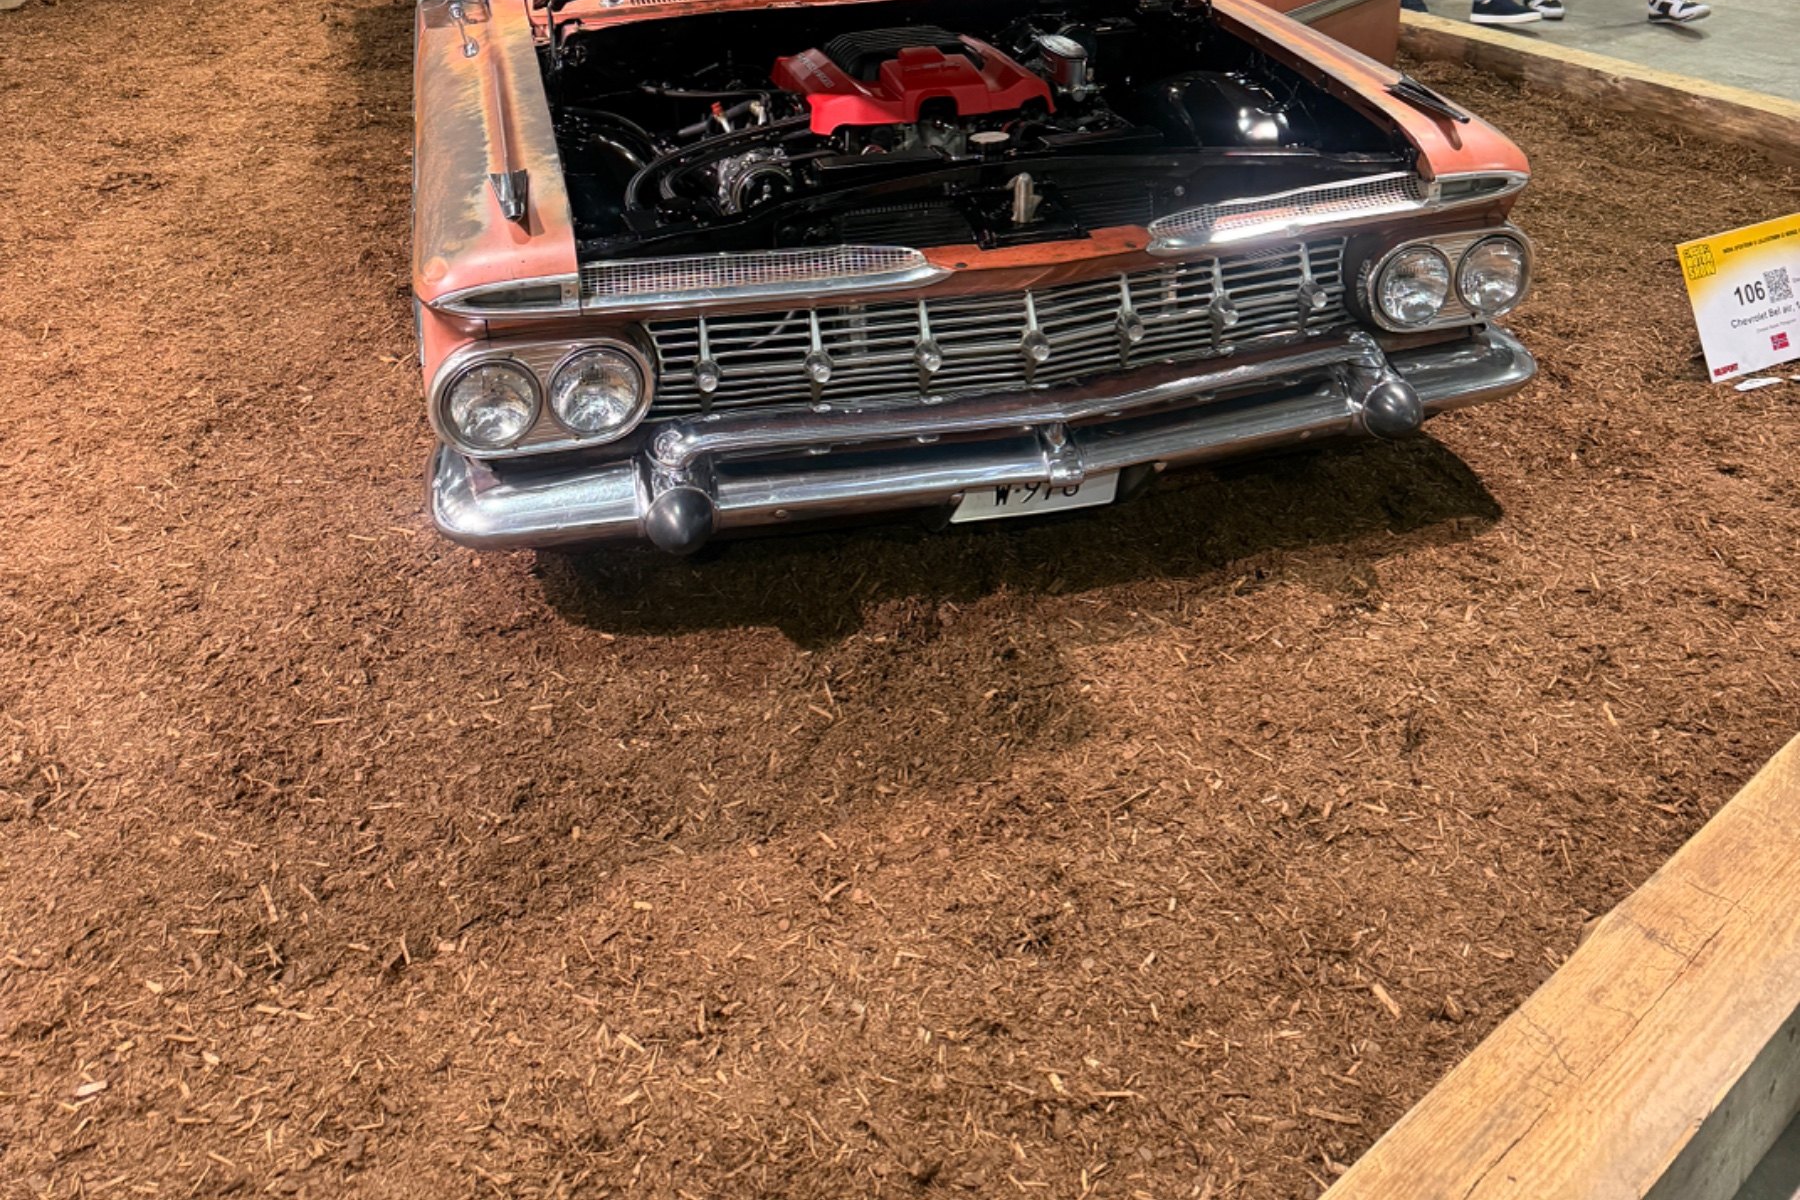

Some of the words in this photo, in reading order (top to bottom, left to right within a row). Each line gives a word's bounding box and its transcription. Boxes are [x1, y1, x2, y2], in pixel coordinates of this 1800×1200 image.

[1687, 263, 1716, 280] SHOW
[1734, 281, 1766, 306] 106
[1730, 311, 1768, 329] Chevrolet
[1768, 306, 1782, 318] Bel
